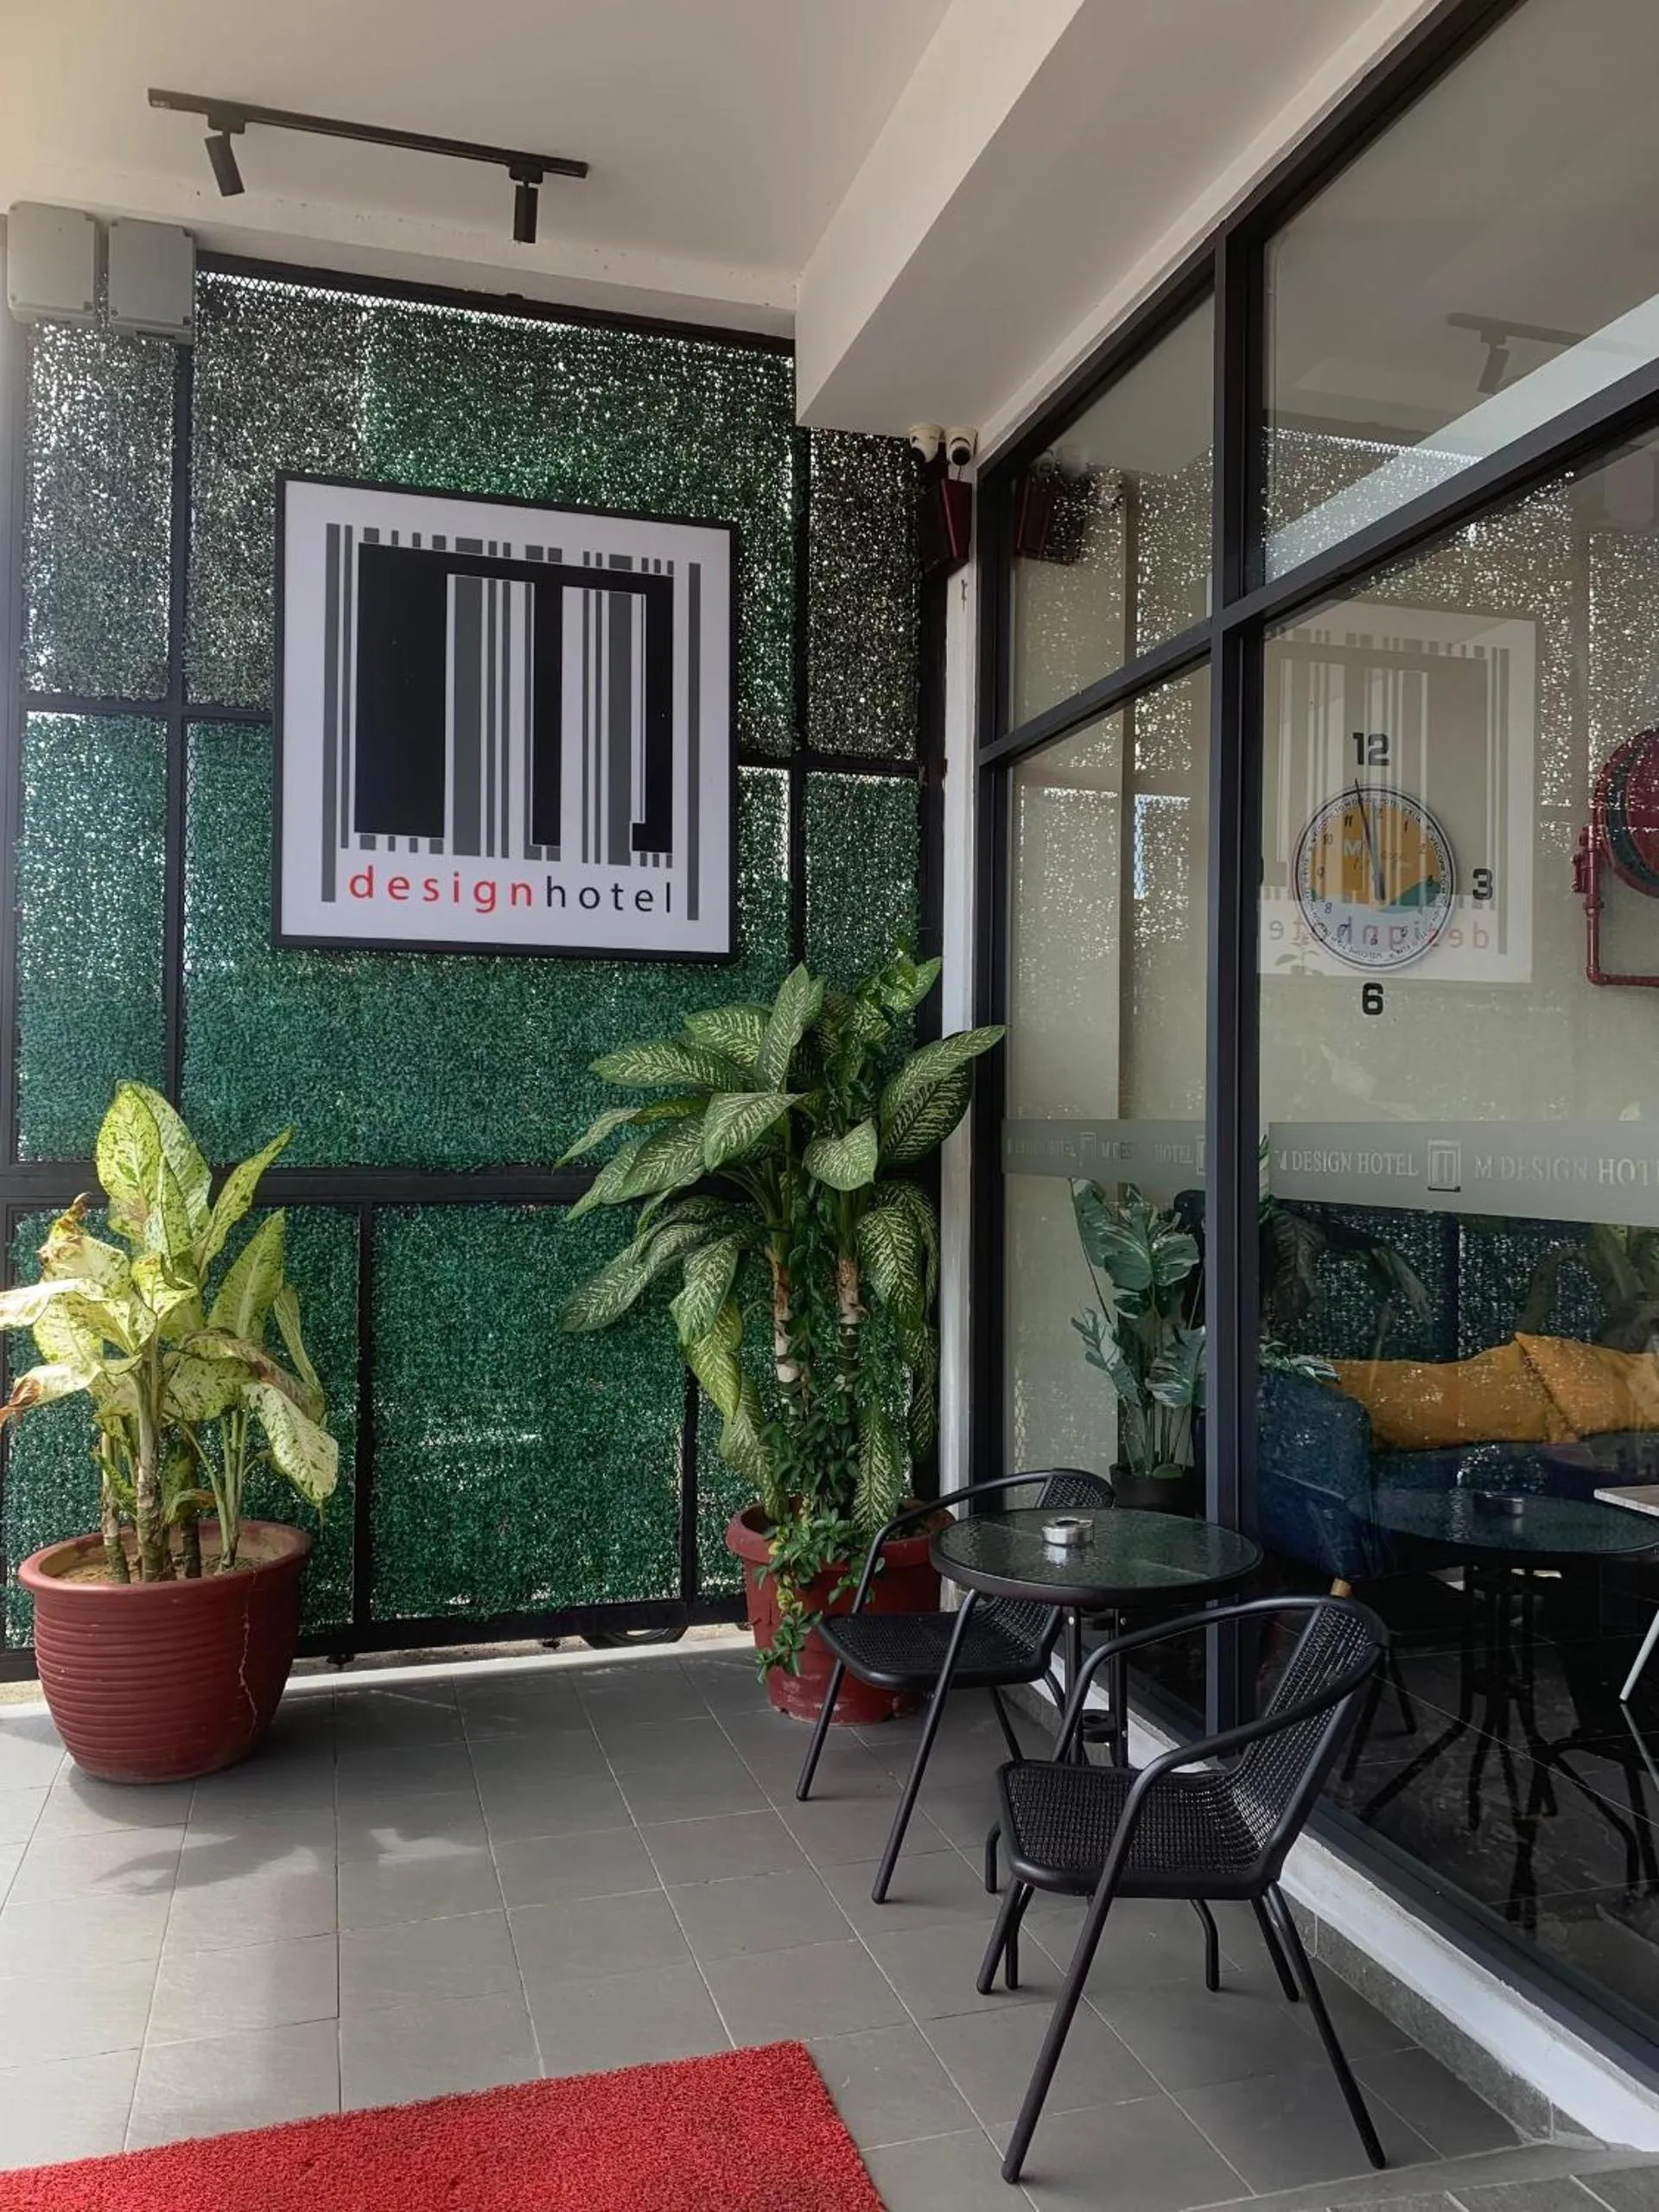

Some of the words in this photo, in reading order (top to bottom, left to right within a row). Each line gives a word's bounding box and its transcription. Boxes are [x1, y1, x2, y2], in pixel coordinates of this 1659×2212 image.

[1353, 732, 1390, 766] 12
[1471, 868, 1493, 901] 3
[1362, 982, 1384, 1016] 6
[1292, 1150, 1353, 1173] DESIGN
[1357, 1151, 1420, 1177] HOTEL
[1473, 1155, 1493, 1179] M
[1500, 1156, 1590, 1181] DESIGN
[1599, 1158, 1659, 1186] HOT
